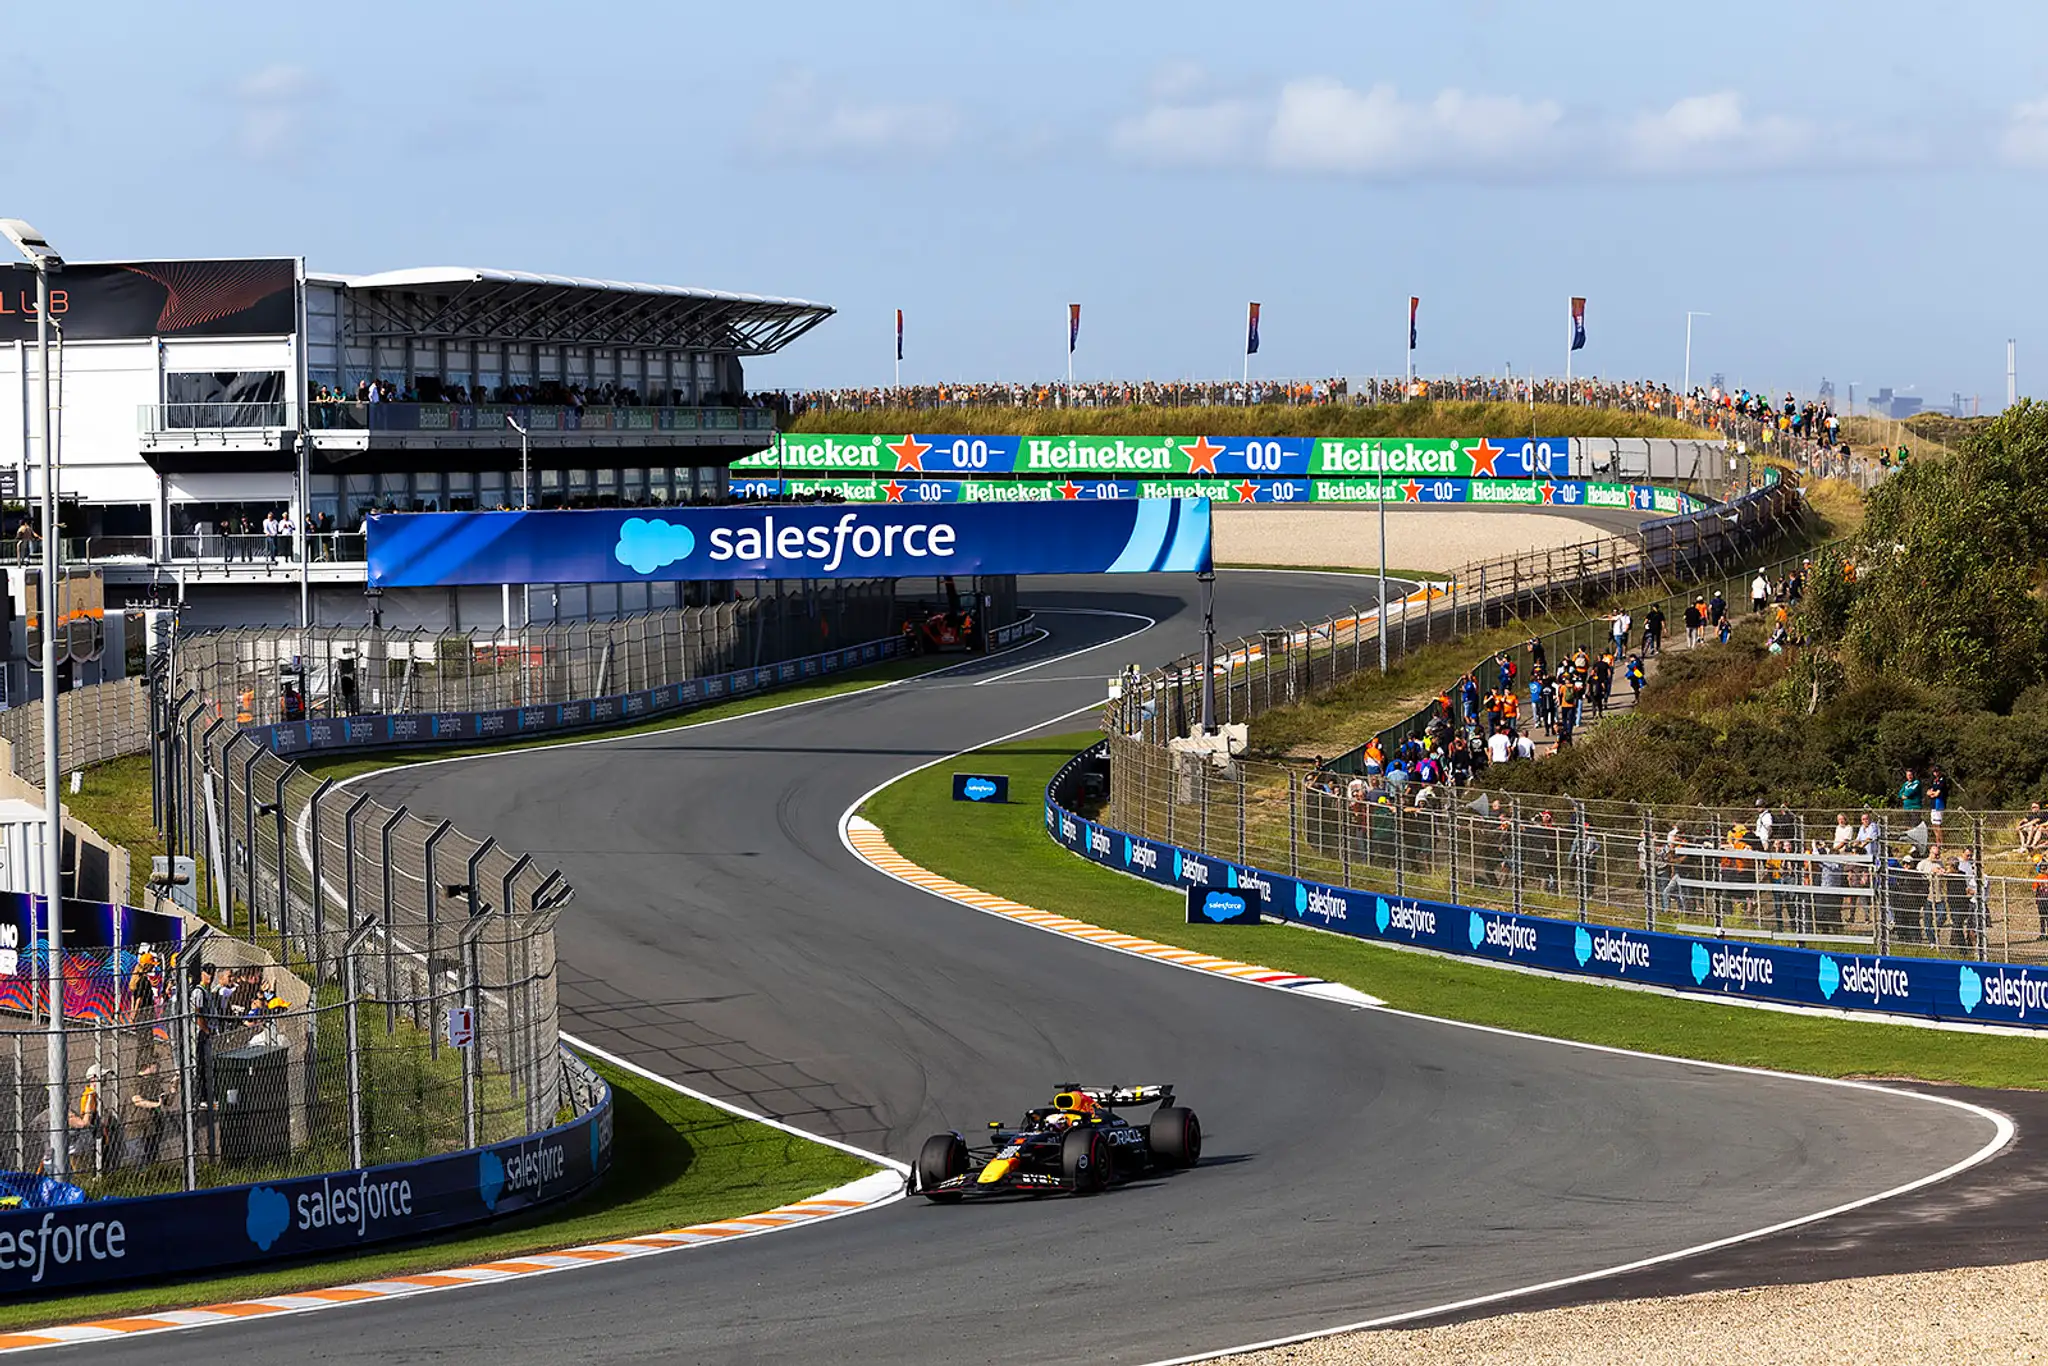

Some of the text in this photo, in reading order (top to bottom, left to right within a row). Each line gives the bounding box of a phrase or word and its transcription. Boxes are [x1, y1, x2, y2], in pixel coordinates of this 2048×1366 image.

[1028, 440, 1171, 469] Heineken
[1321, 441, 1456, 472] Heineken
[966, 483, 1052, 501] Heineken
[1318, 482, 1397, 501] Heineken
[1472, 483, 1536, 501] Heineken
[709, 514, 956, 571] salesforce
[1182, 854, 1208, 886] salesforce
[1208, 900, 1242, 910] salesforce
[1308, 886, 1347, 924] salesforce
[1391, 901, 1436, 939] salesforce
[1486, 915, 1537, 956] salesforce
[1593, 930, 1650, 973] salesforce
[1712, 945, 1773, 990] salesforce
[1842, 957, 1909, 1004] salesforce
[507, 1137, 564, 1197] salesforce
[298, 1172, 412, 1236] salesforce
